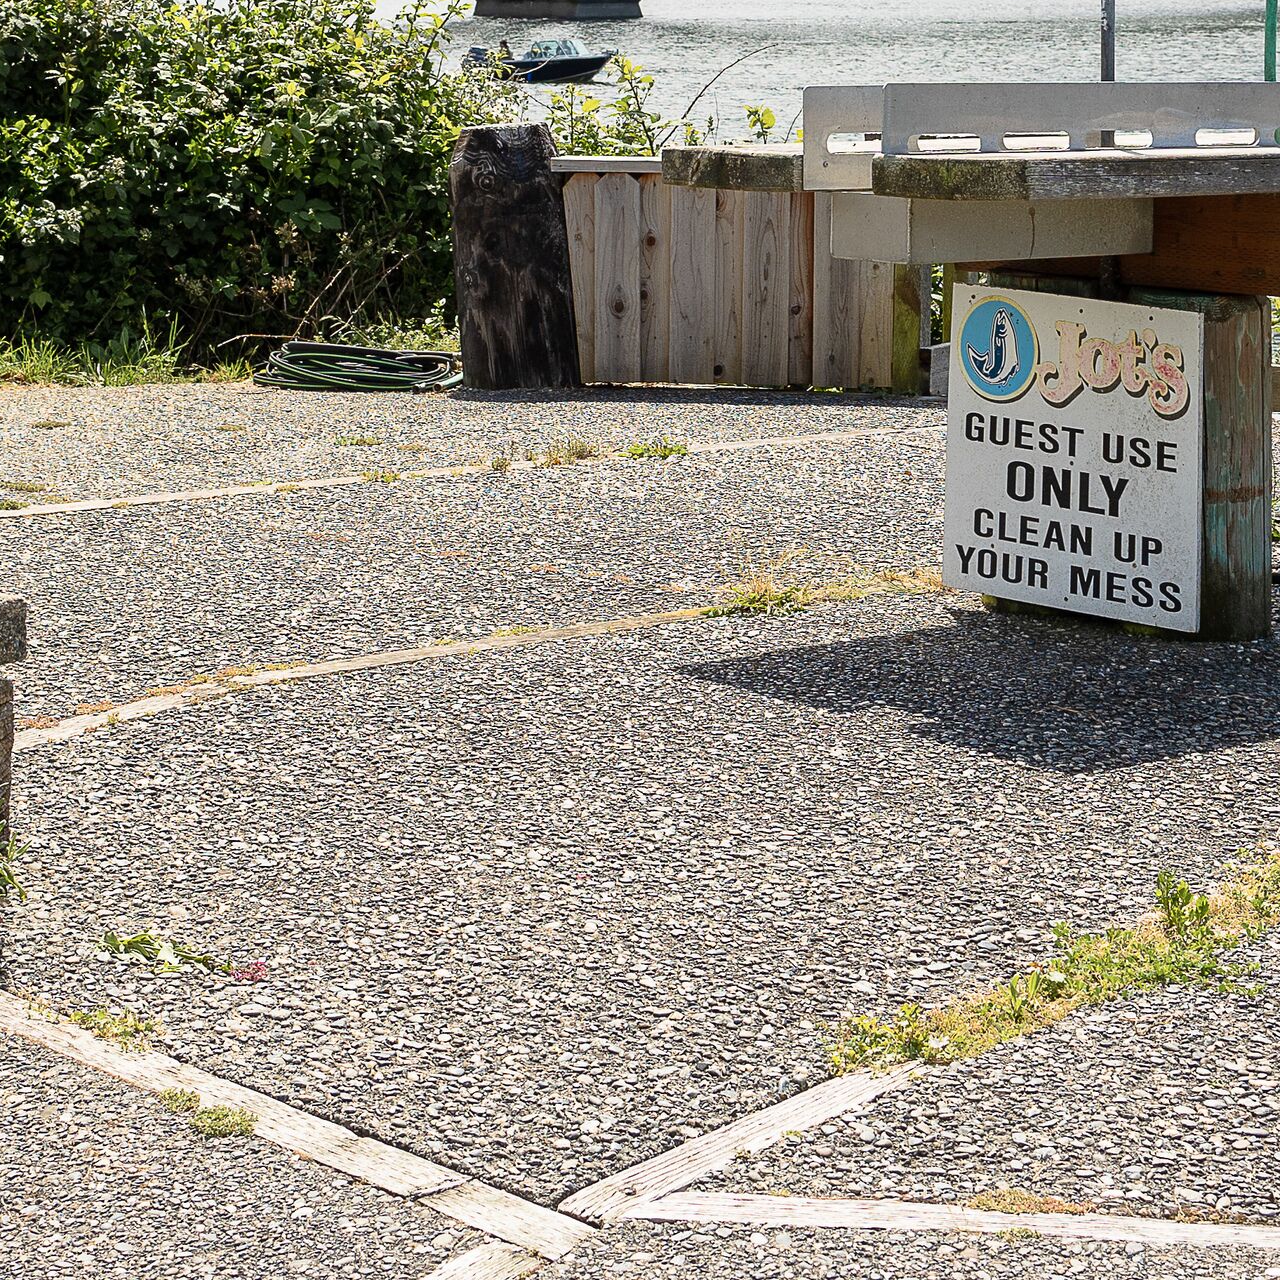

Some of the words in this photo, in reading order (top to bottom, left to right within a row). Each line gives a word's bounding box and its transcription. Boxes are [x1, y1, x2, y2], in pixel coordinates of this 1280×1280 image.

[965, 412, 1084, 457] GUEST
[1102, 432, 1178, 473] USE
[1006, 460, 1129, 518] ONLY
[973, 508, 1093, 556] CLEAN
[1114, 531, 1163, 566] UP
[955, 544, 1049, 589] YOUR
[1069, 565, 1182, 613] MESS
